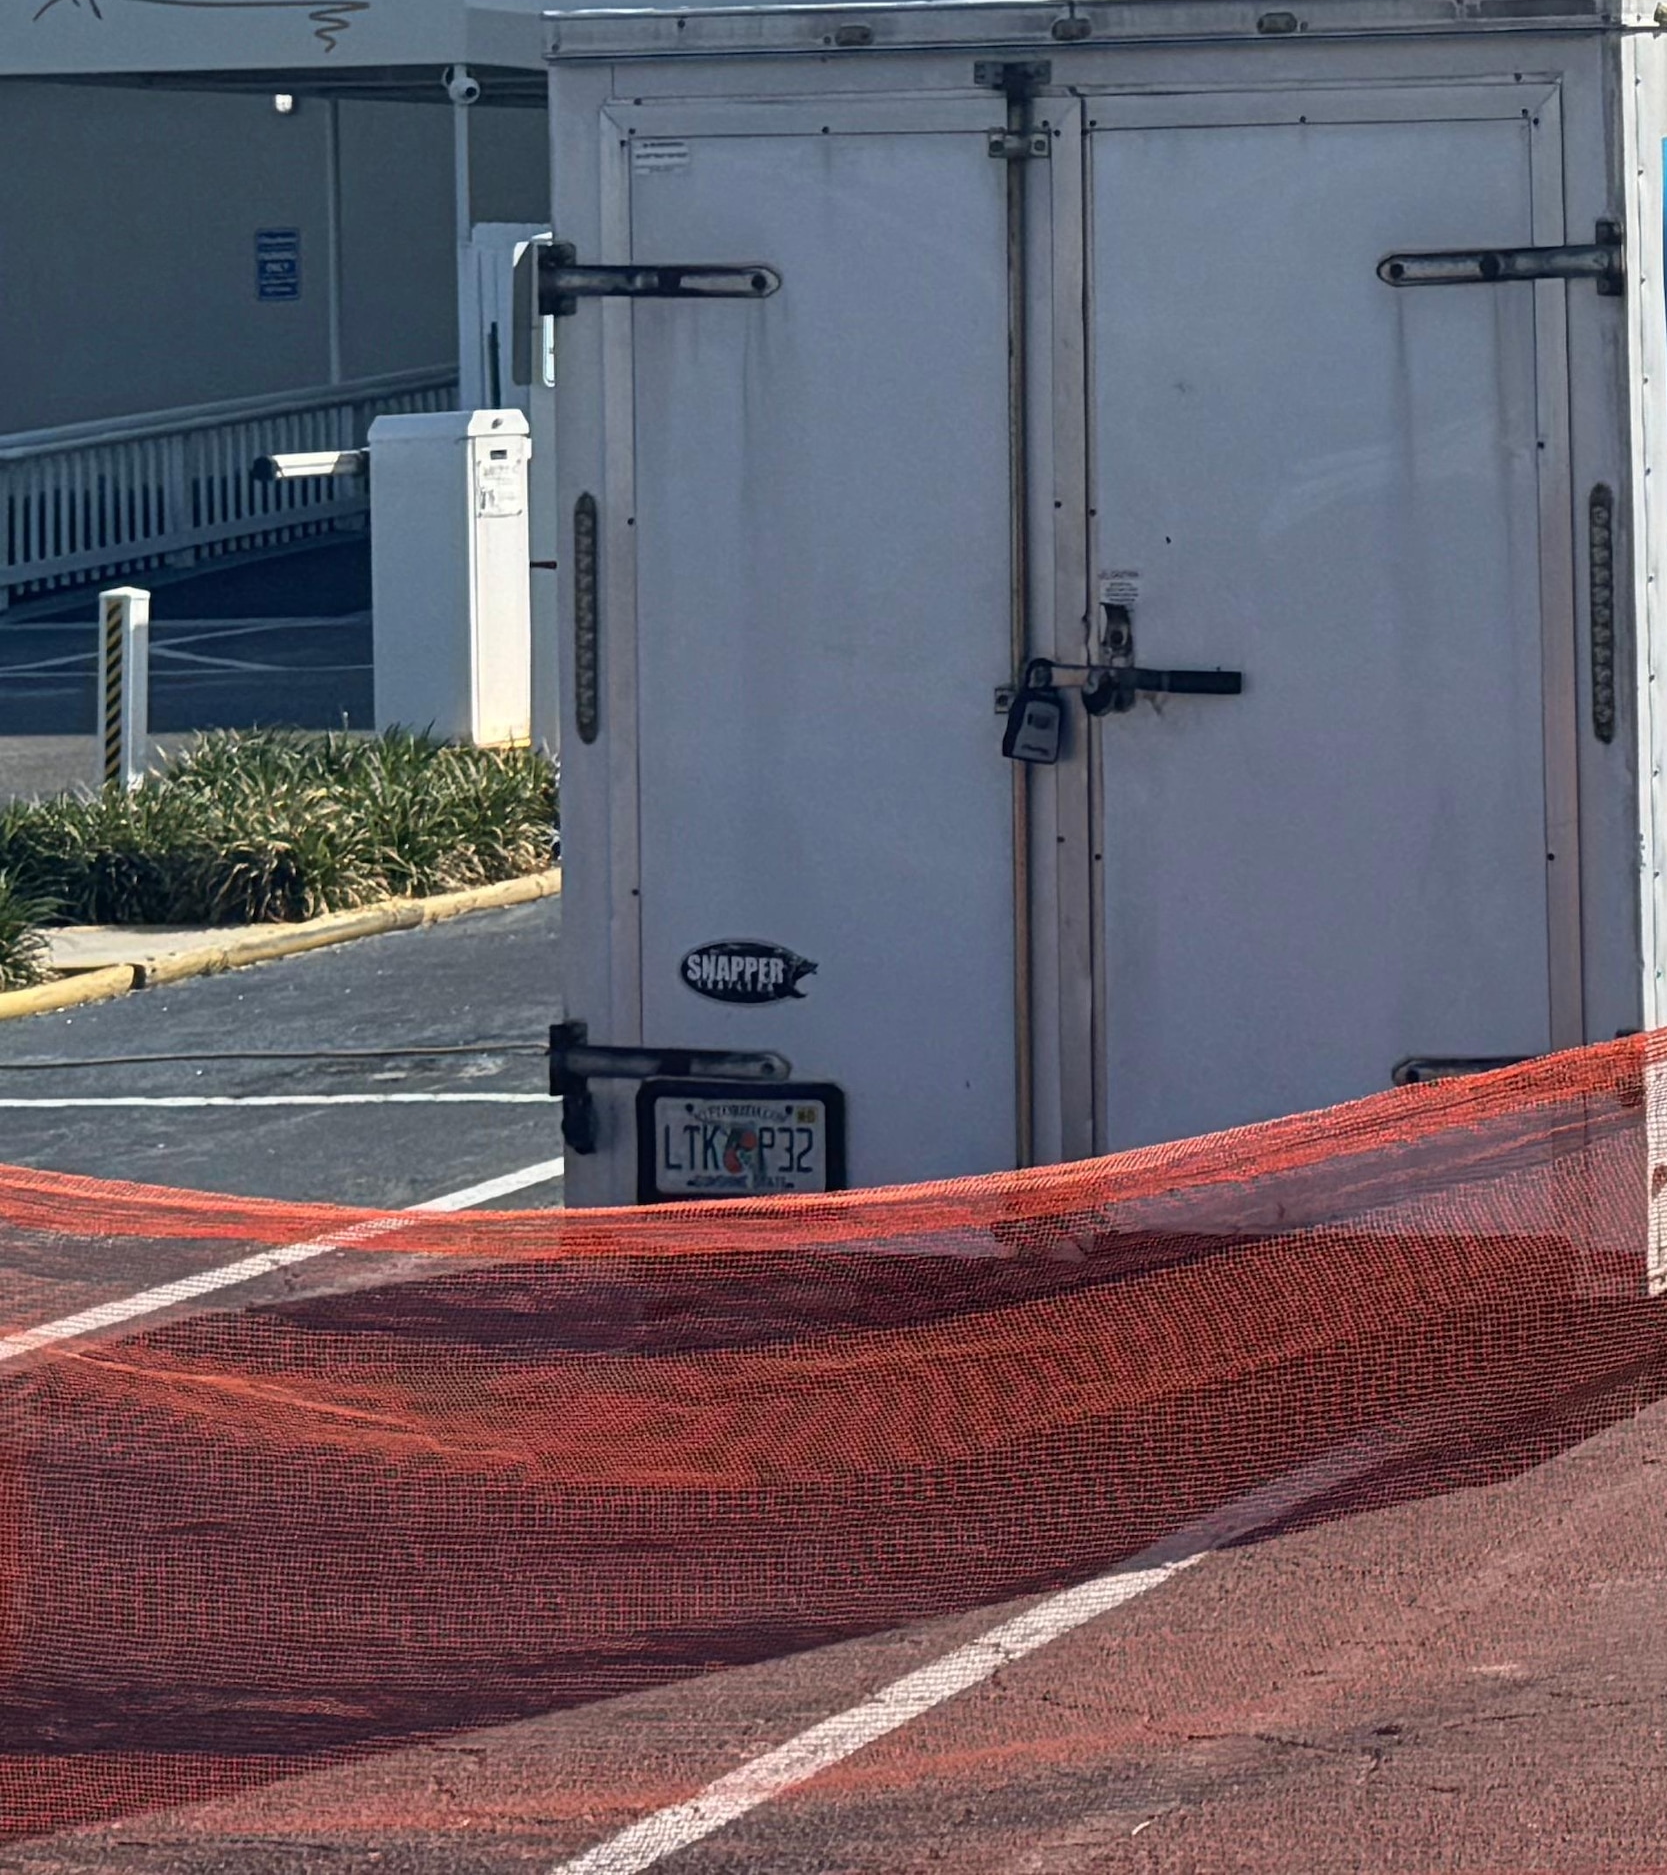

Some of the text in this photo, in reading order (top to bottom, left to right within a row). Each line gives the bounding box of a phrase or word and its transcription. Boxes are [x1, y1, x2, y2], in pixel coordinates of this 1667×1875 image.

[686, 953, 785, 985] SNAPPER
[664, 1124, 814, 1173] LTK P32
